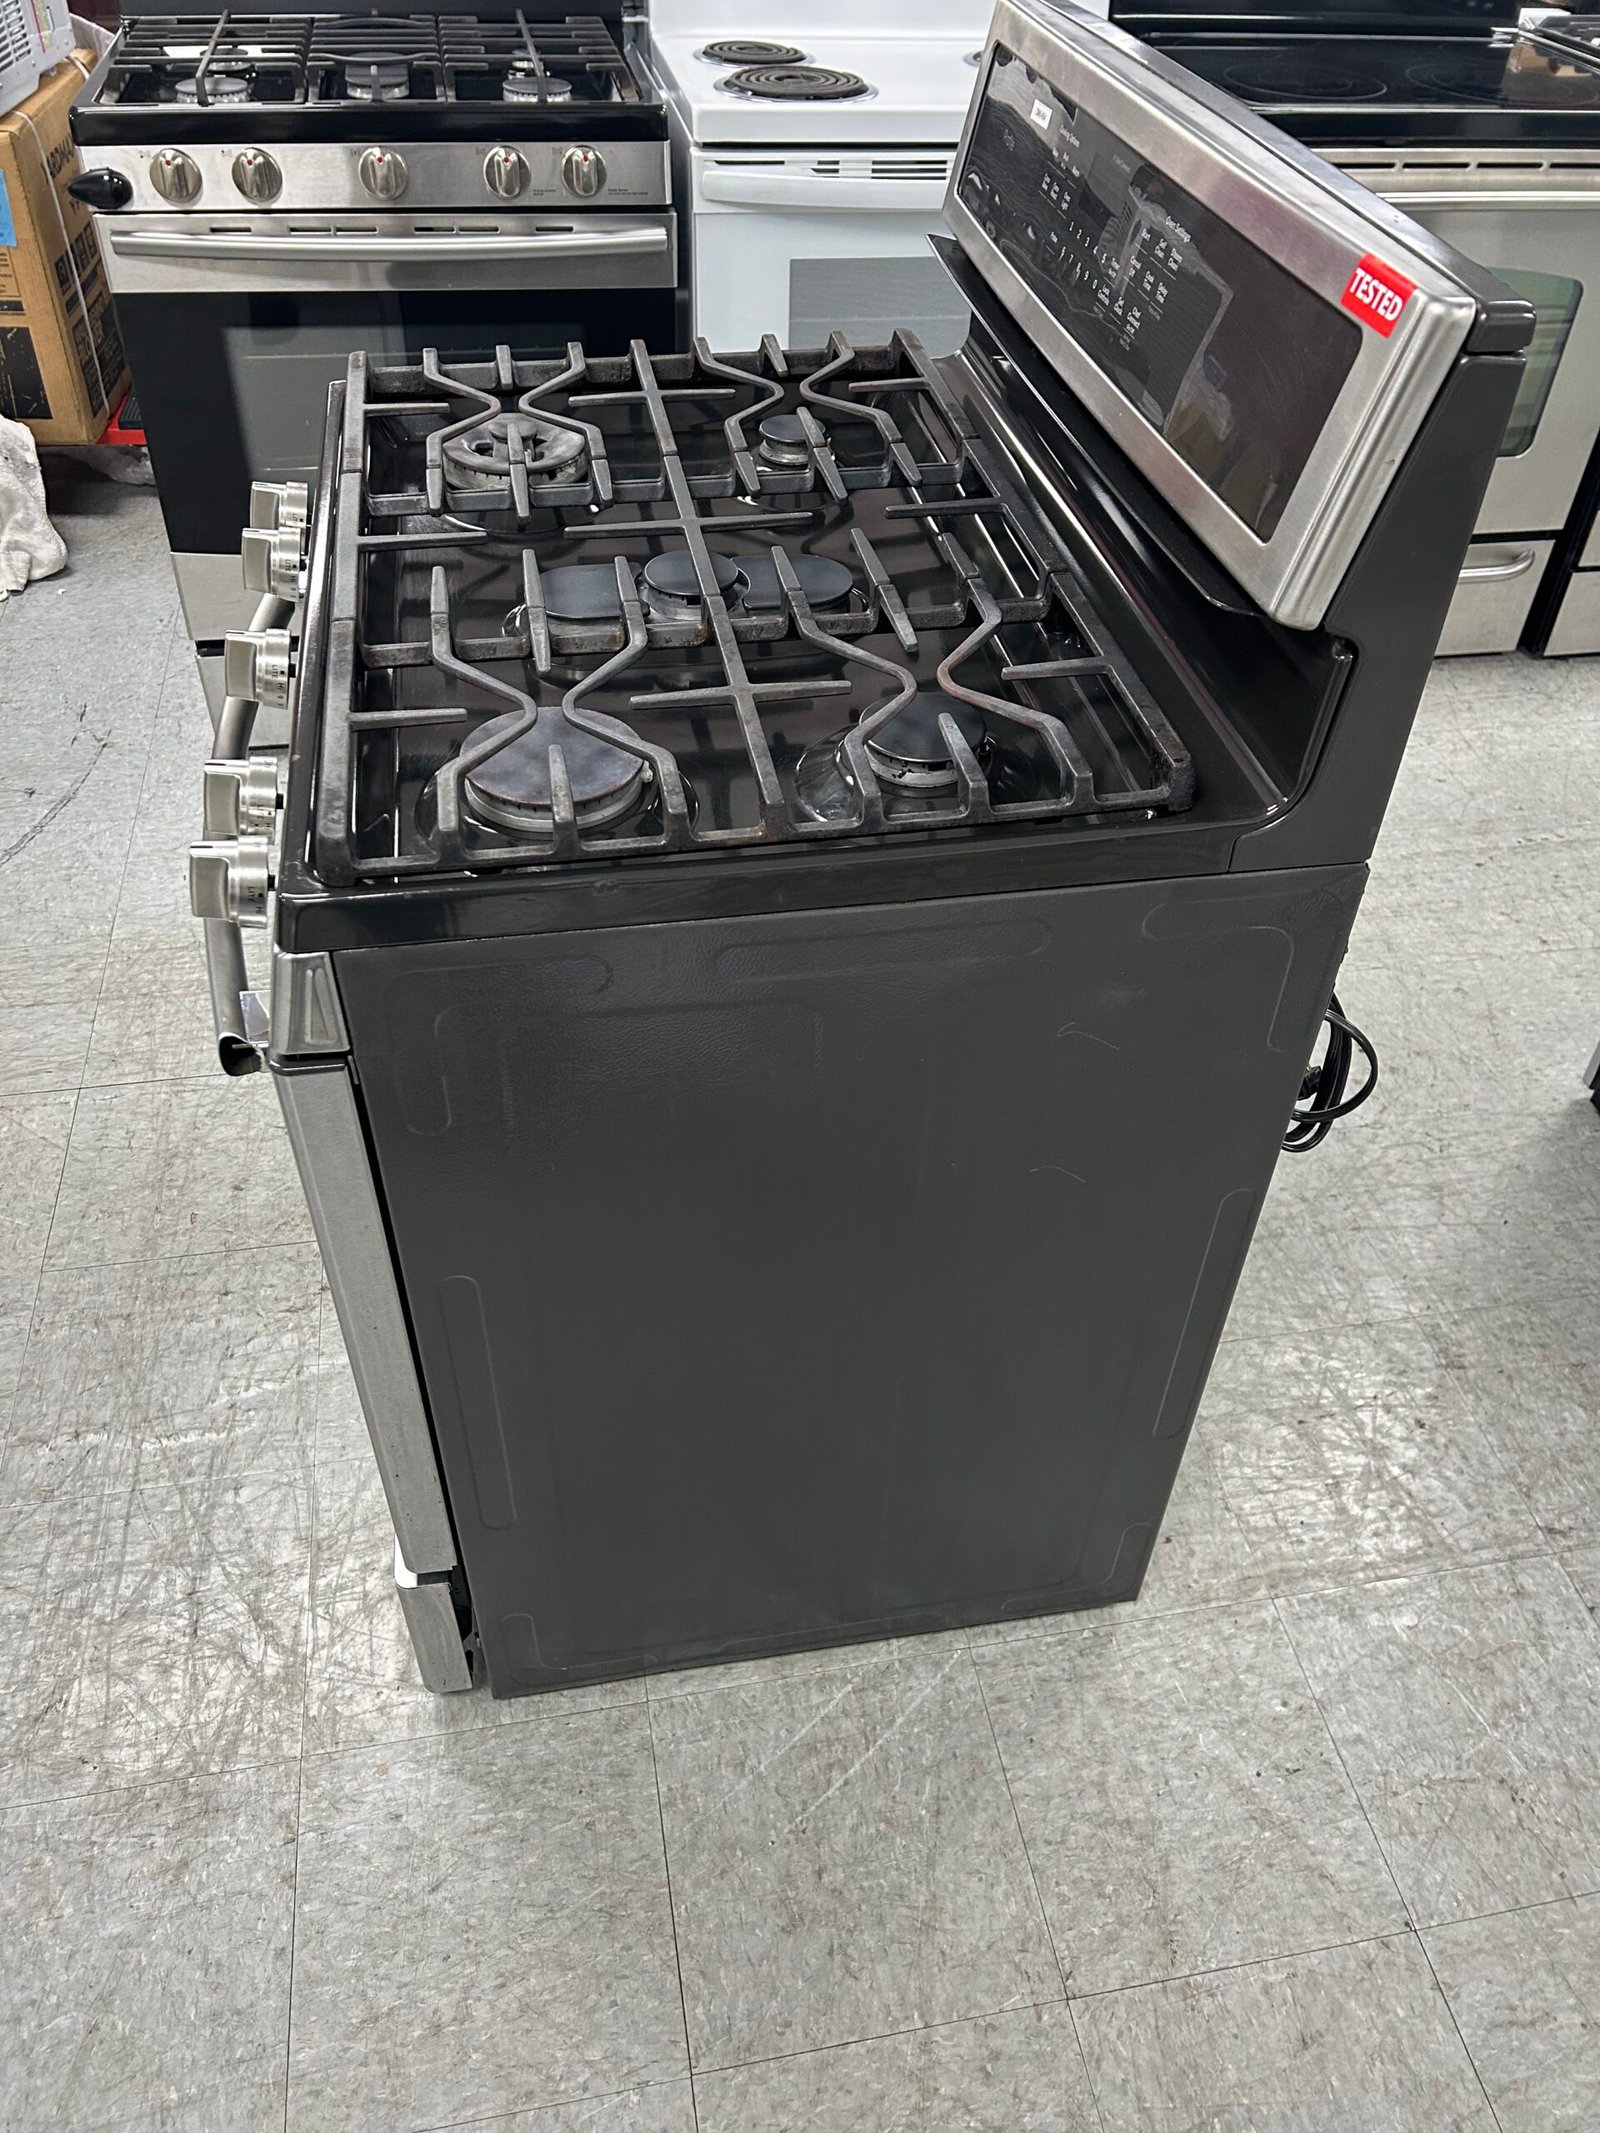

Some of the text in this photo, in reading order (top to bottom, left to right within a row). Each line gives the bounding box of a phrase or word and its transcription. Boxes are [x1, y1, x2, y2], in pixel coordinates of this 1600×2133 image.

[1165, 215, 1191, 243] Oven Settings
[1349, 267, 1403, 321] TESTED
